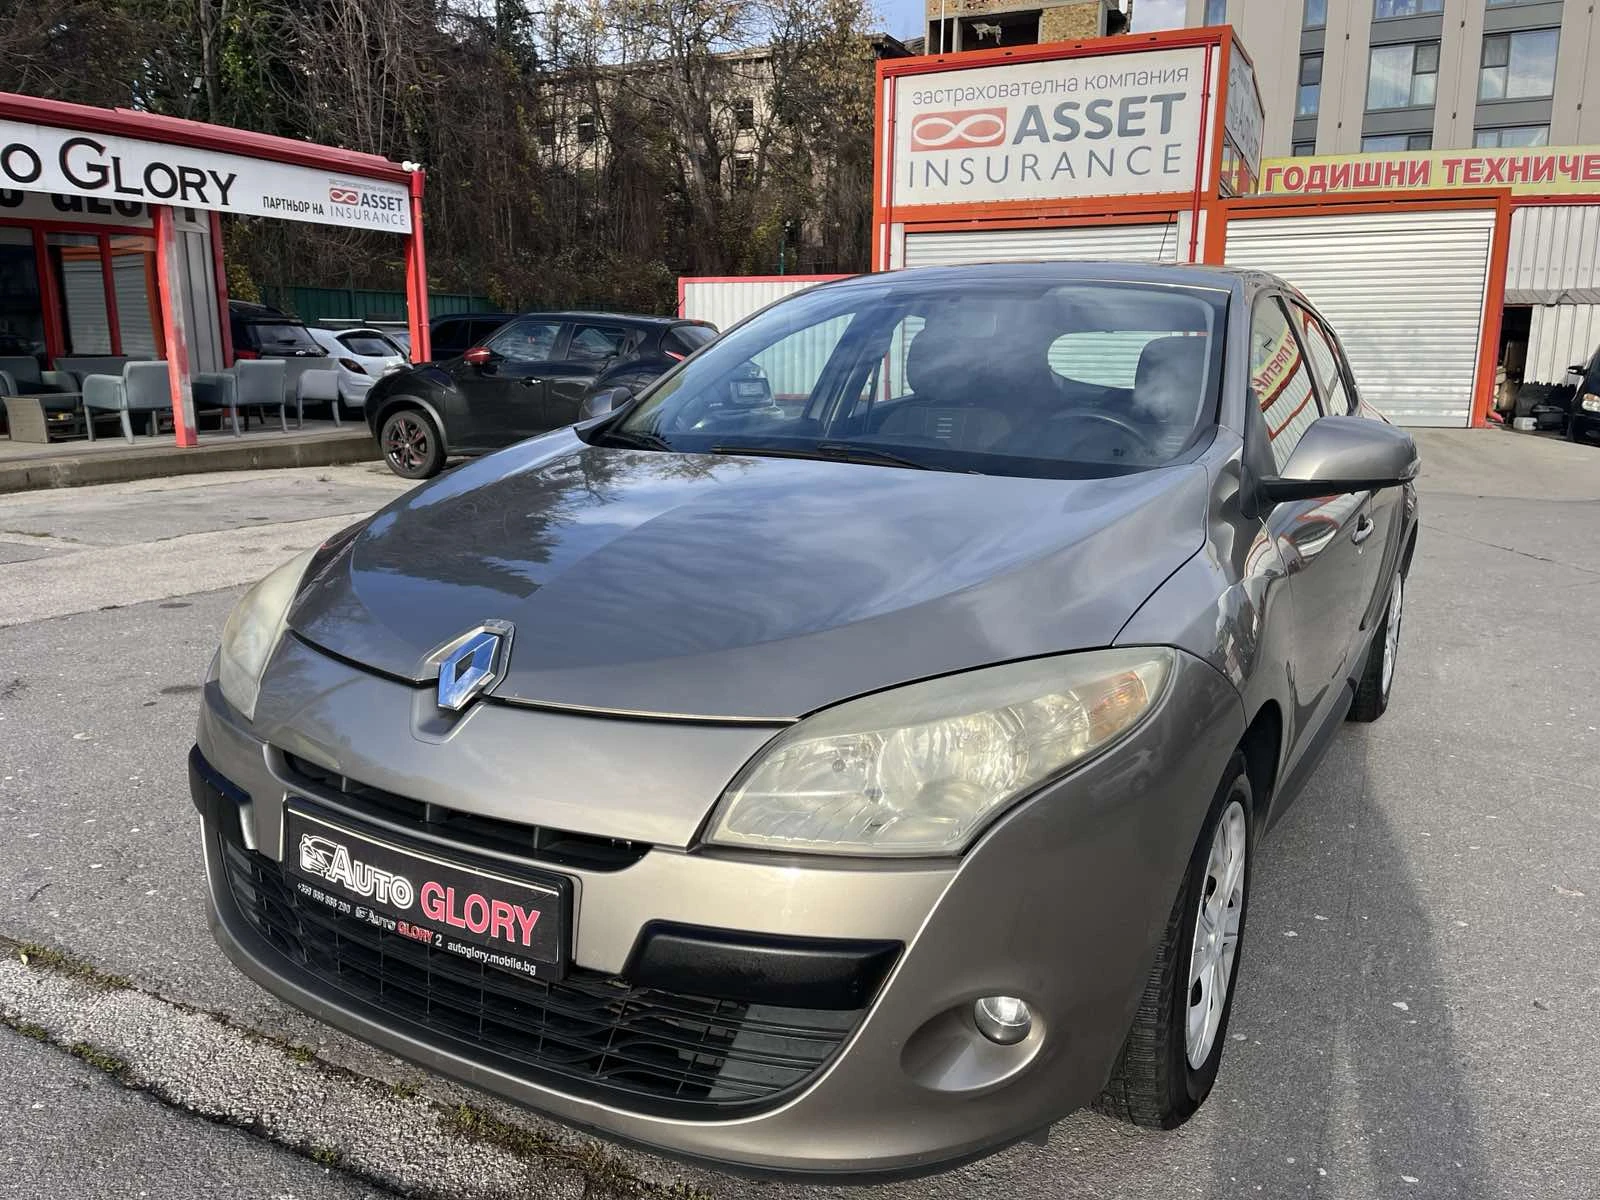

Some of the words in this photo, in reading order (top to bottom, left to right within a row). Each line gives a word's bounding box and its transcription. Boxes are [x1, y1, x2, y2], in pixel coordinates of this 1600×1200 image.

[912, 75, 1078, 107] застрахователна
[1084, 67, 1189, 90] компания
[1012, 92, 1187, 145] ASSET
[59, 137, 238, 206] GLORY
[909, 143, 1182, 188] INSURANCE
[1264, 158, 1432, 193] ГОДИШНИ
[1442, 154, 1600, 186] ТЕХНИЧЕ
[263, 196, 310, 214] ПАРТНЬОР
[312, 203, 325, 216] НА
[329, 205, 405, 226] INSURANCE
[361, 193, 403, 212] ASSET
[420, 881, 541, 947] GLORY
[397, 920, 433, 944] GLORY
[435, 934, 443, 947] 2
[447, 941, 536, 976] autoglory.mobile.bg
